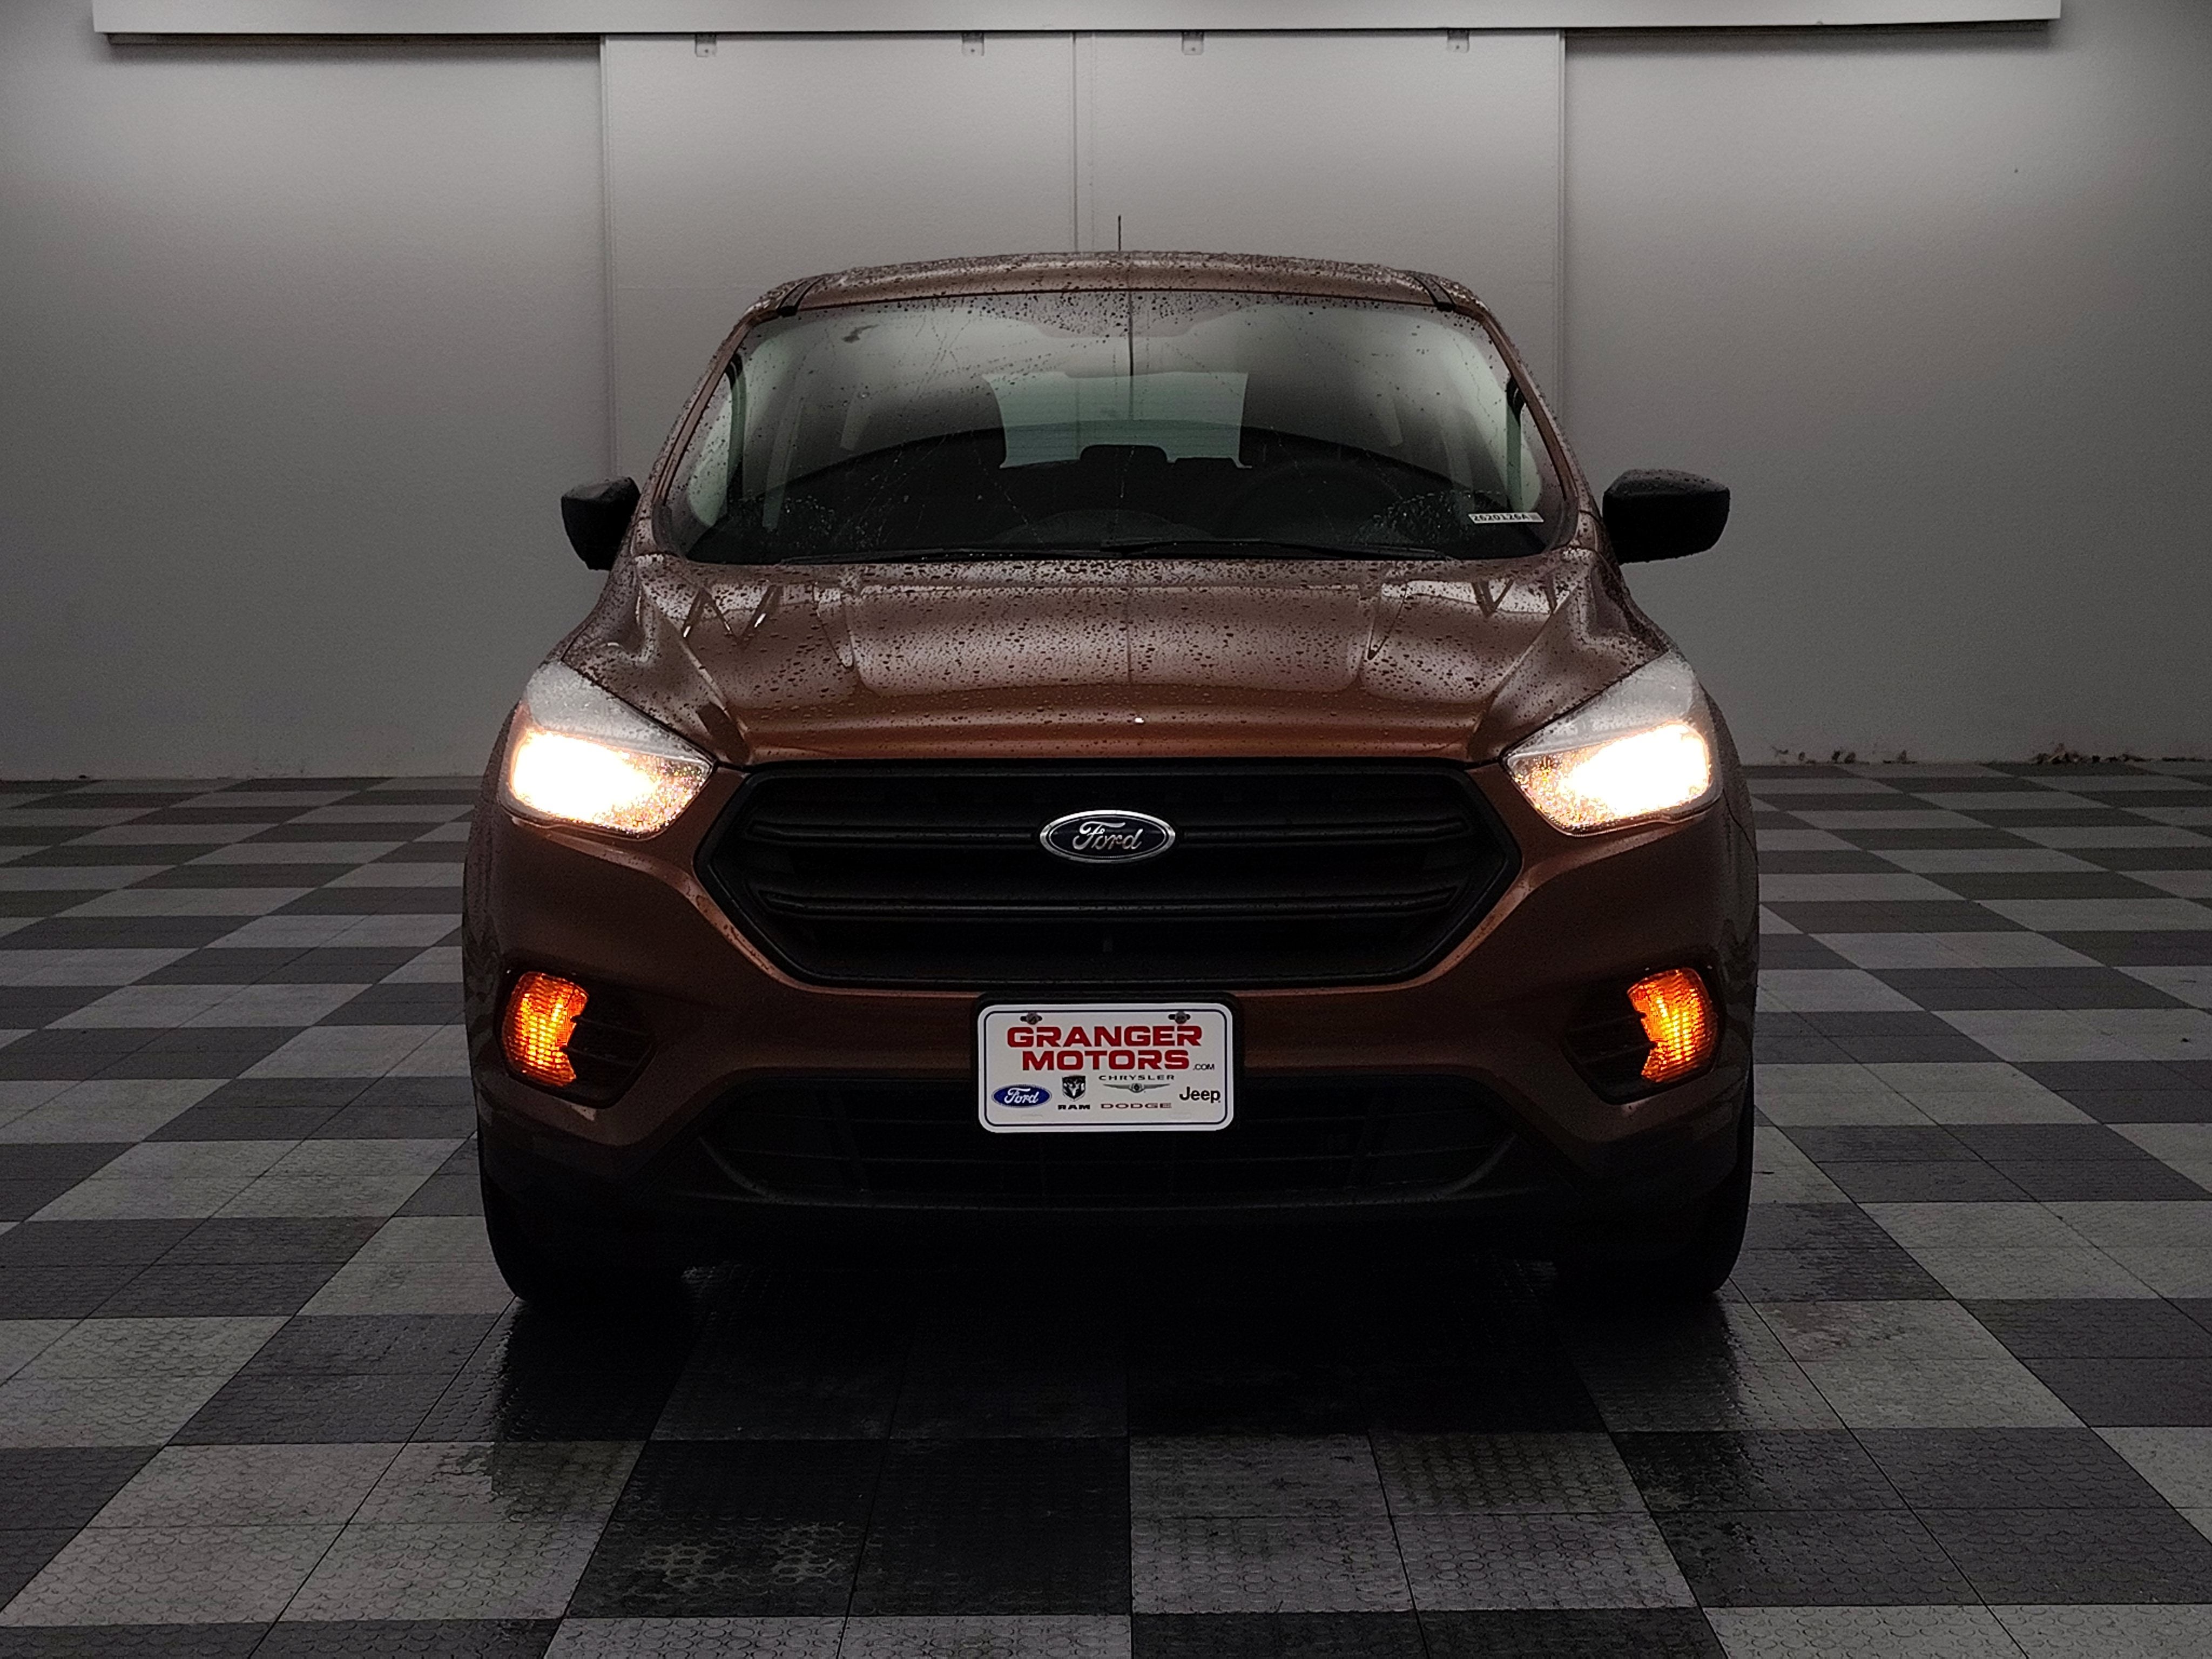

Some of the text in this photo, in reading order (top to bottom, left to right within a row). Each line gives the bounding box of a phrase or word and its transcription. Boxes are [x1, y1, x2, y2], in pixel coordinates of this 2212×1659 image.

[1072, 821, 1143, 850] Ford
[1007, 1026, 1202, 1047] GRANGER
[1022, 1050, 1190, 1070] MOTORS
[1004, 1088, 1039, 1104] Ford
[1179, 1087, 1220, 1103] Jeep
